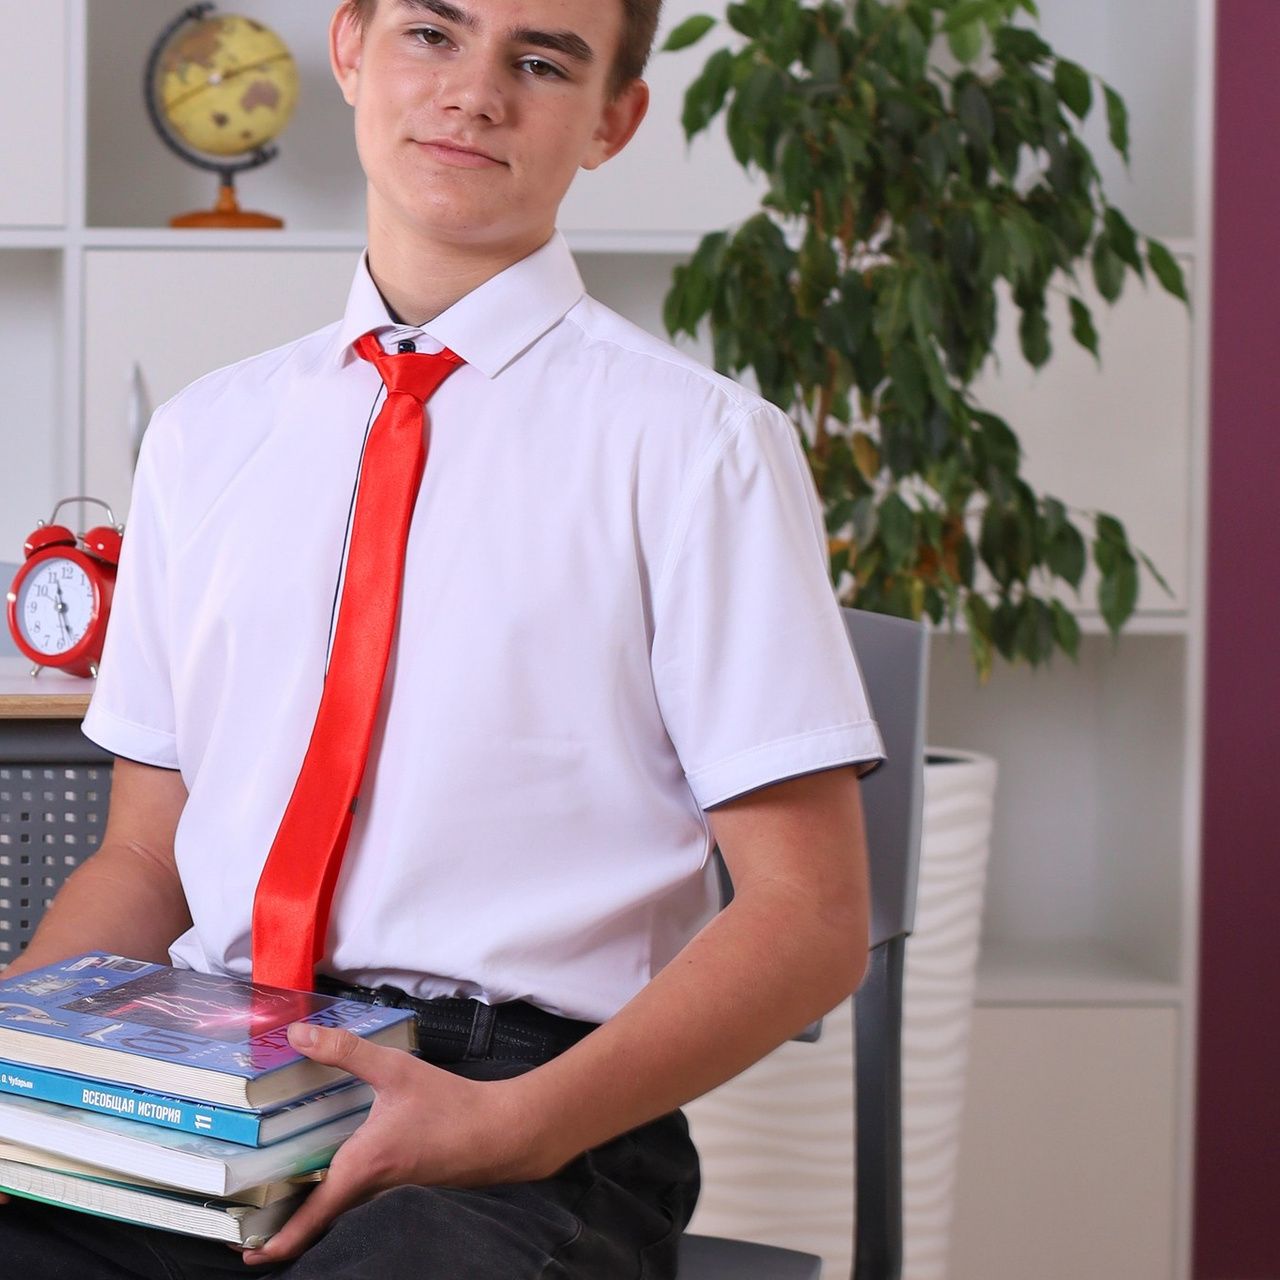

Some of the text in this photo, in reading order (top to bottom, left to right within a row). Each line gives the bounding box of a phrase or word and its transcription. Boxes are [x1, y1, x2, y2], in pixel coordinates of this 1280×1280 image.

[48, 572, 57, 584] 11
[61, 567, 74, 579] 12
[37, 585, 49, 597] 10
[31, 602, 37, 613] 9
[34, 621, 41, 633] 8
[44, 635, 50, 647] 7
[57, 637, 64, 650] 6
[250, 1002, 376, 1050] ФИЗКА
[82, 1089, 181, 1124] ВСЕОБЩАЯ ИСТОРИЯ
[194, 1114, 212, 1130] 11
